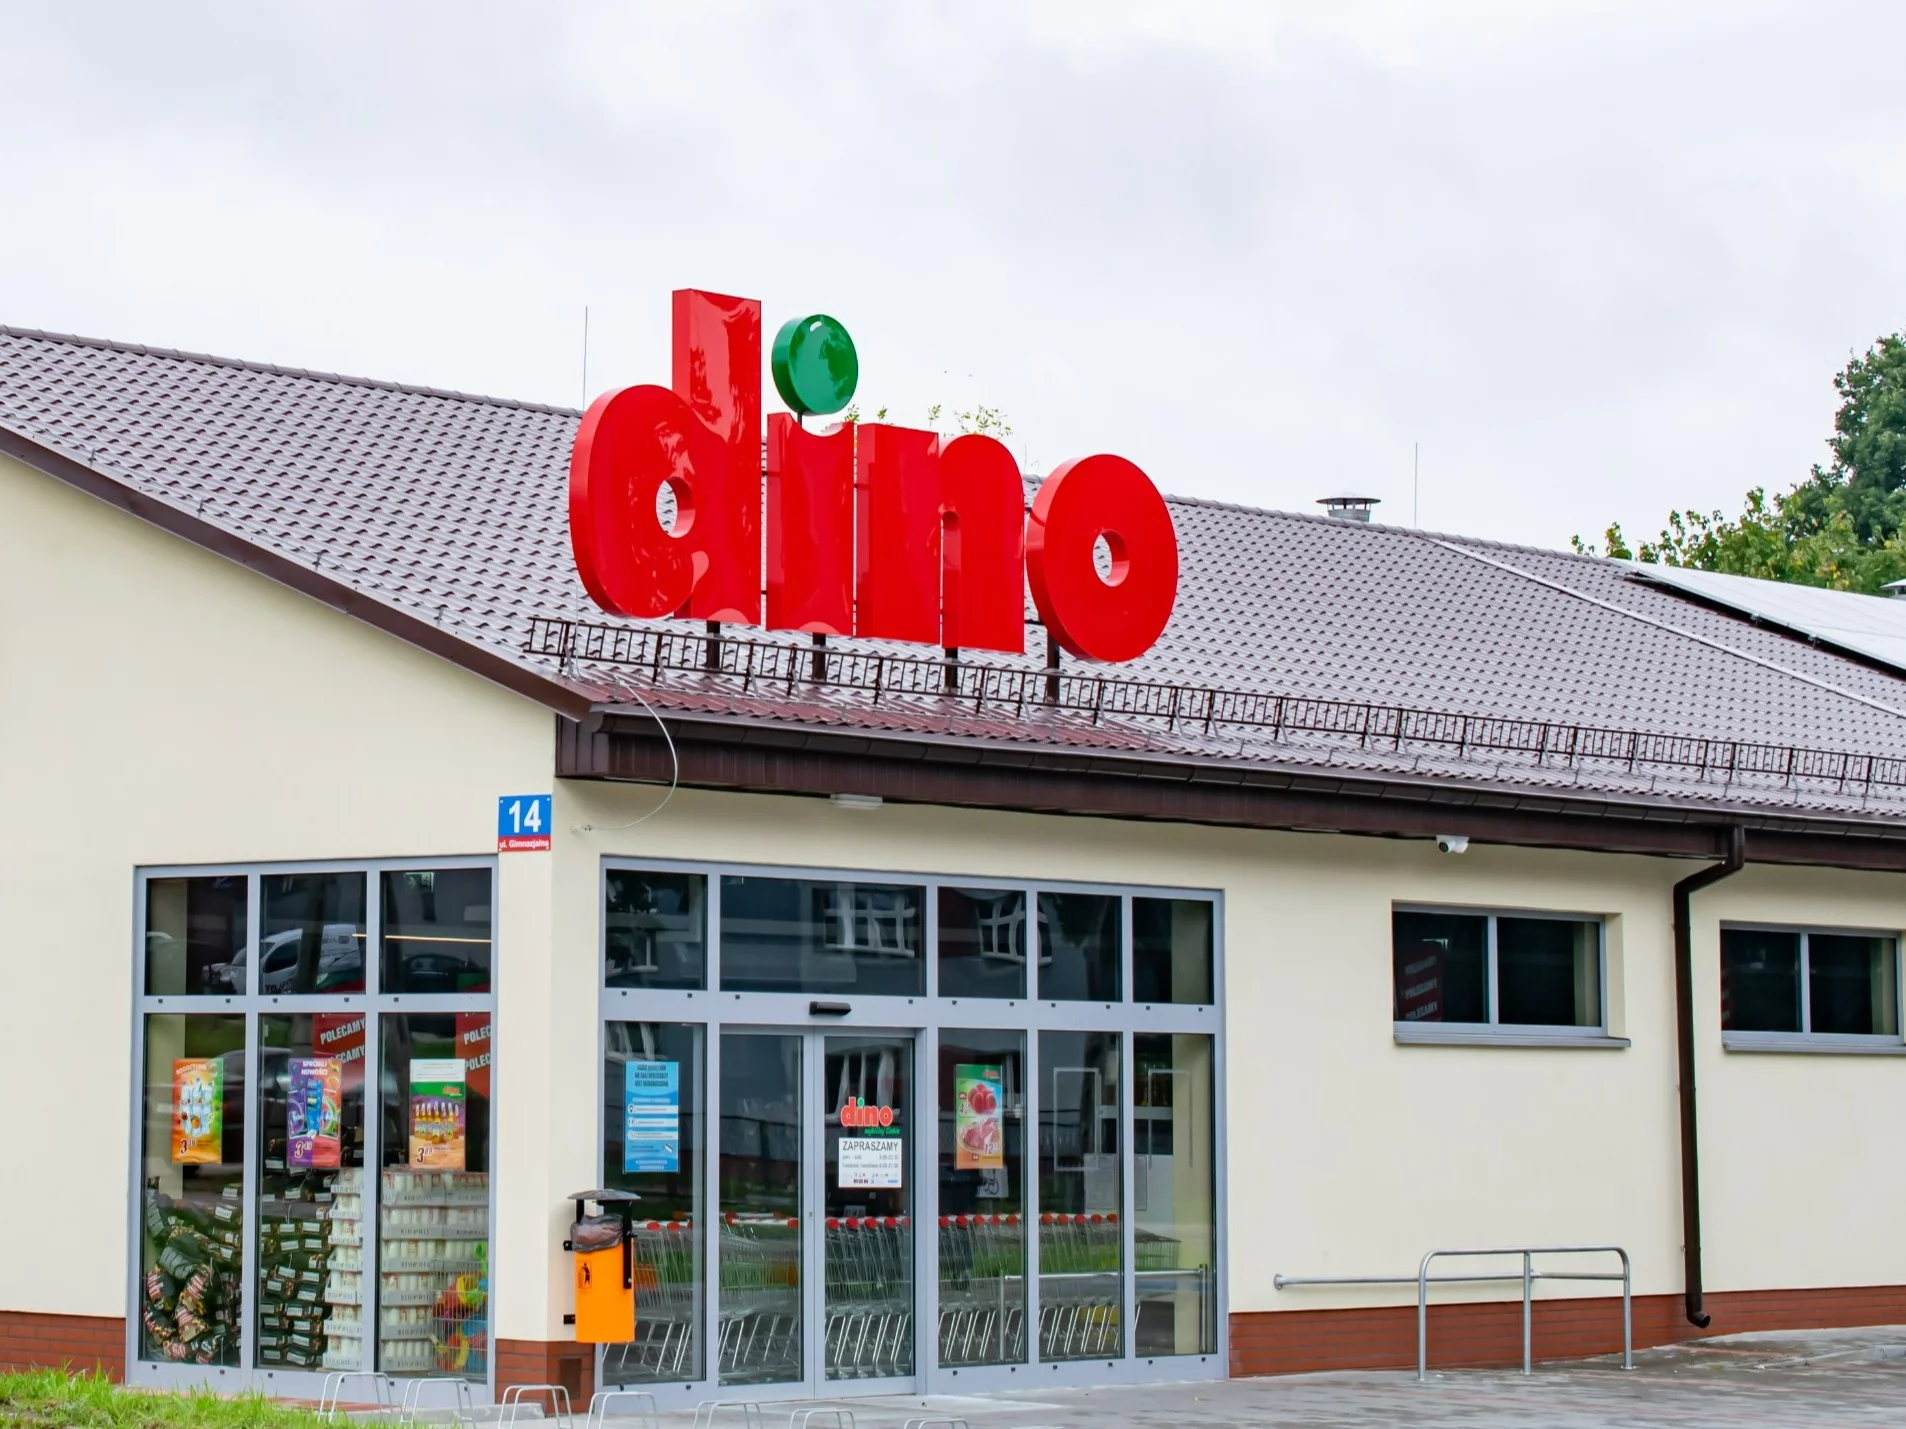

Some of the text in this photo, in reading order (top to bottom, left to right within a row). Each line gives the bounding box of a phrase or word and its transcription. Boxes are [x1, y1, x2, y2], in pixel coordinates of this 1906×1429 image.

[569, 288, 1179, 662] dino
[508, 799, 542, 833] 14
[508, 839, 549, 849] Gimnazjalna
[320, 1016, 365, 1045] POLECAMY
[840, 1096, 893, 1127] dino
[842, 1141, 899, 1151] ZAPRASZAMY
